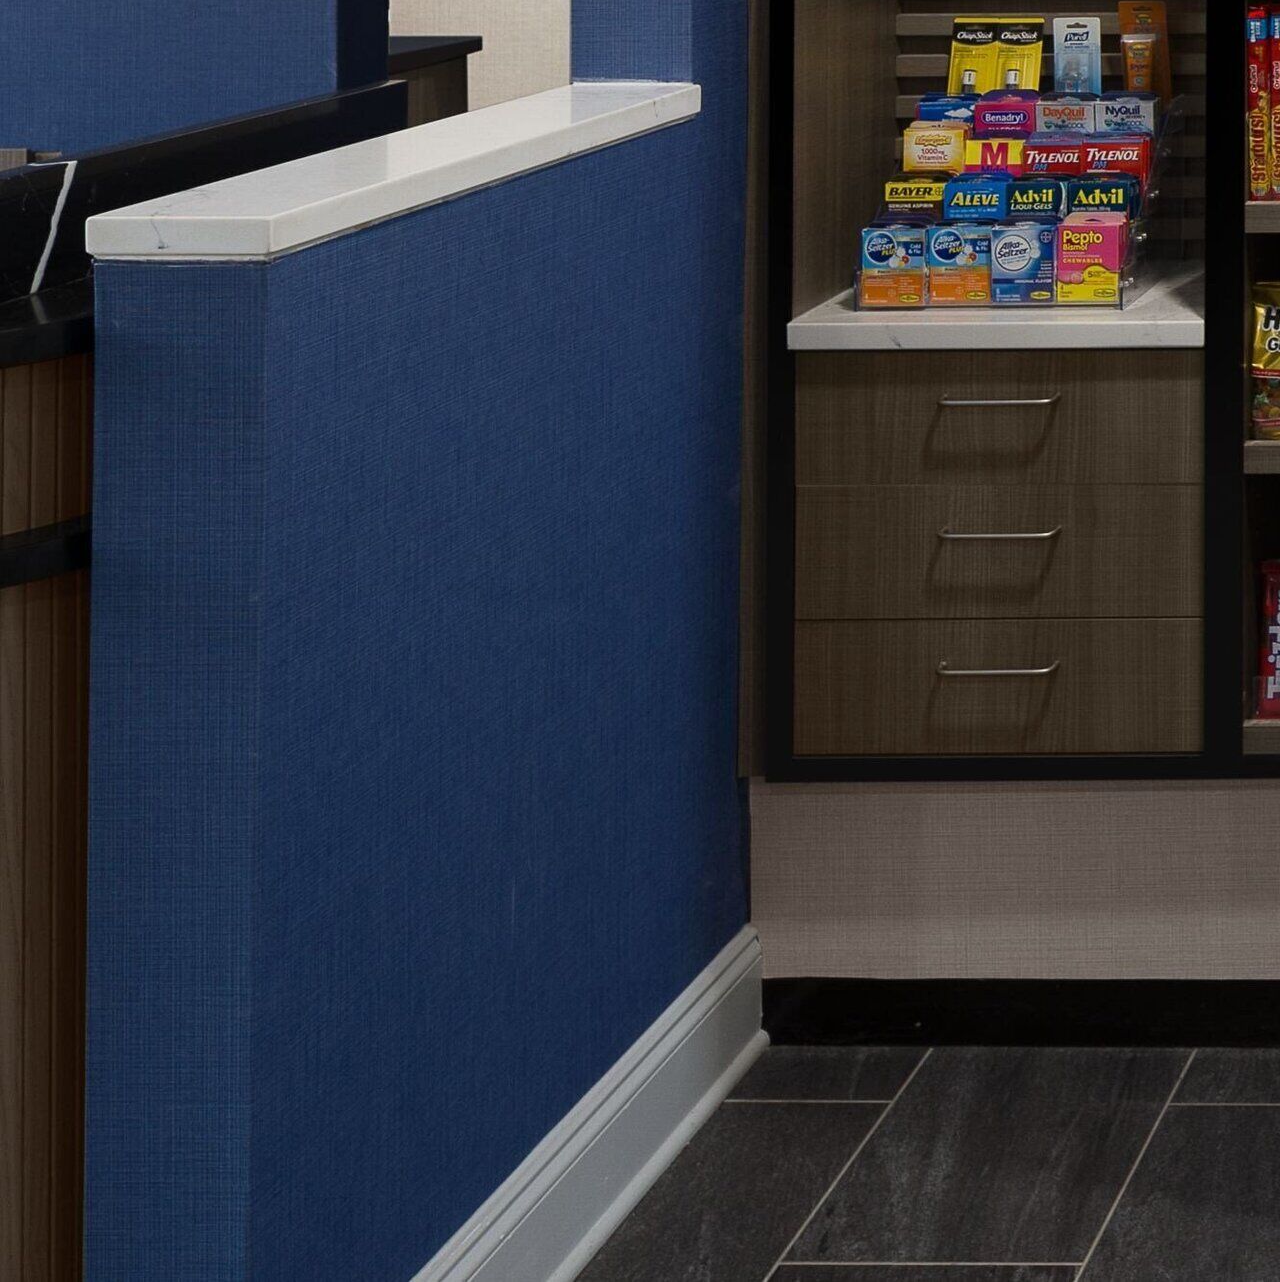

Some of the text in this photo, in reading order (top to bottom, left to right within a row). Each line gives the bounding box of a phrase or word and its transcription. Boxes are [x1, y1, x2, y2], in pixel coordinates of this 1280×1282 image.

[956, 31, 994, 42] ChapStick
[1000, 31, 1039, 42] ChapStick
[1042, 107, 1086, 119] DayQuil
[1104, 105, 1141, 117] NyQuil
[984, 112, 1025, 124] Benadryl
[917, 154, 941, 162] Vitamin
[981, 142, 1009, 165] M
[1026, 150, 1080, 164] TYLENOL
[1086, 148, 1139, 162] TYLENOL
[1032, 163, 1048, 171] PM
[1092, 160, 1108, 169] PM
[888, 186, 934, 198] BAYER
[1010, 189, 1053, 204] Advil
[1073, 188, 1124, 205] Advil
[950, 191, 1000, 207] ALEVE
[1010, 202, 1054, 211] LIQUI-GELS
[1061, 230, 1104, 246] Pepto
[868, 242, 894, 253] Seltzer
[934, 240, 961, 251] Seltzer
[1000, 241, 1024, 251] Alka-
[1062, 243, 1088, 252] Bismol
[997, 247, 1029, 259] Seltzer
